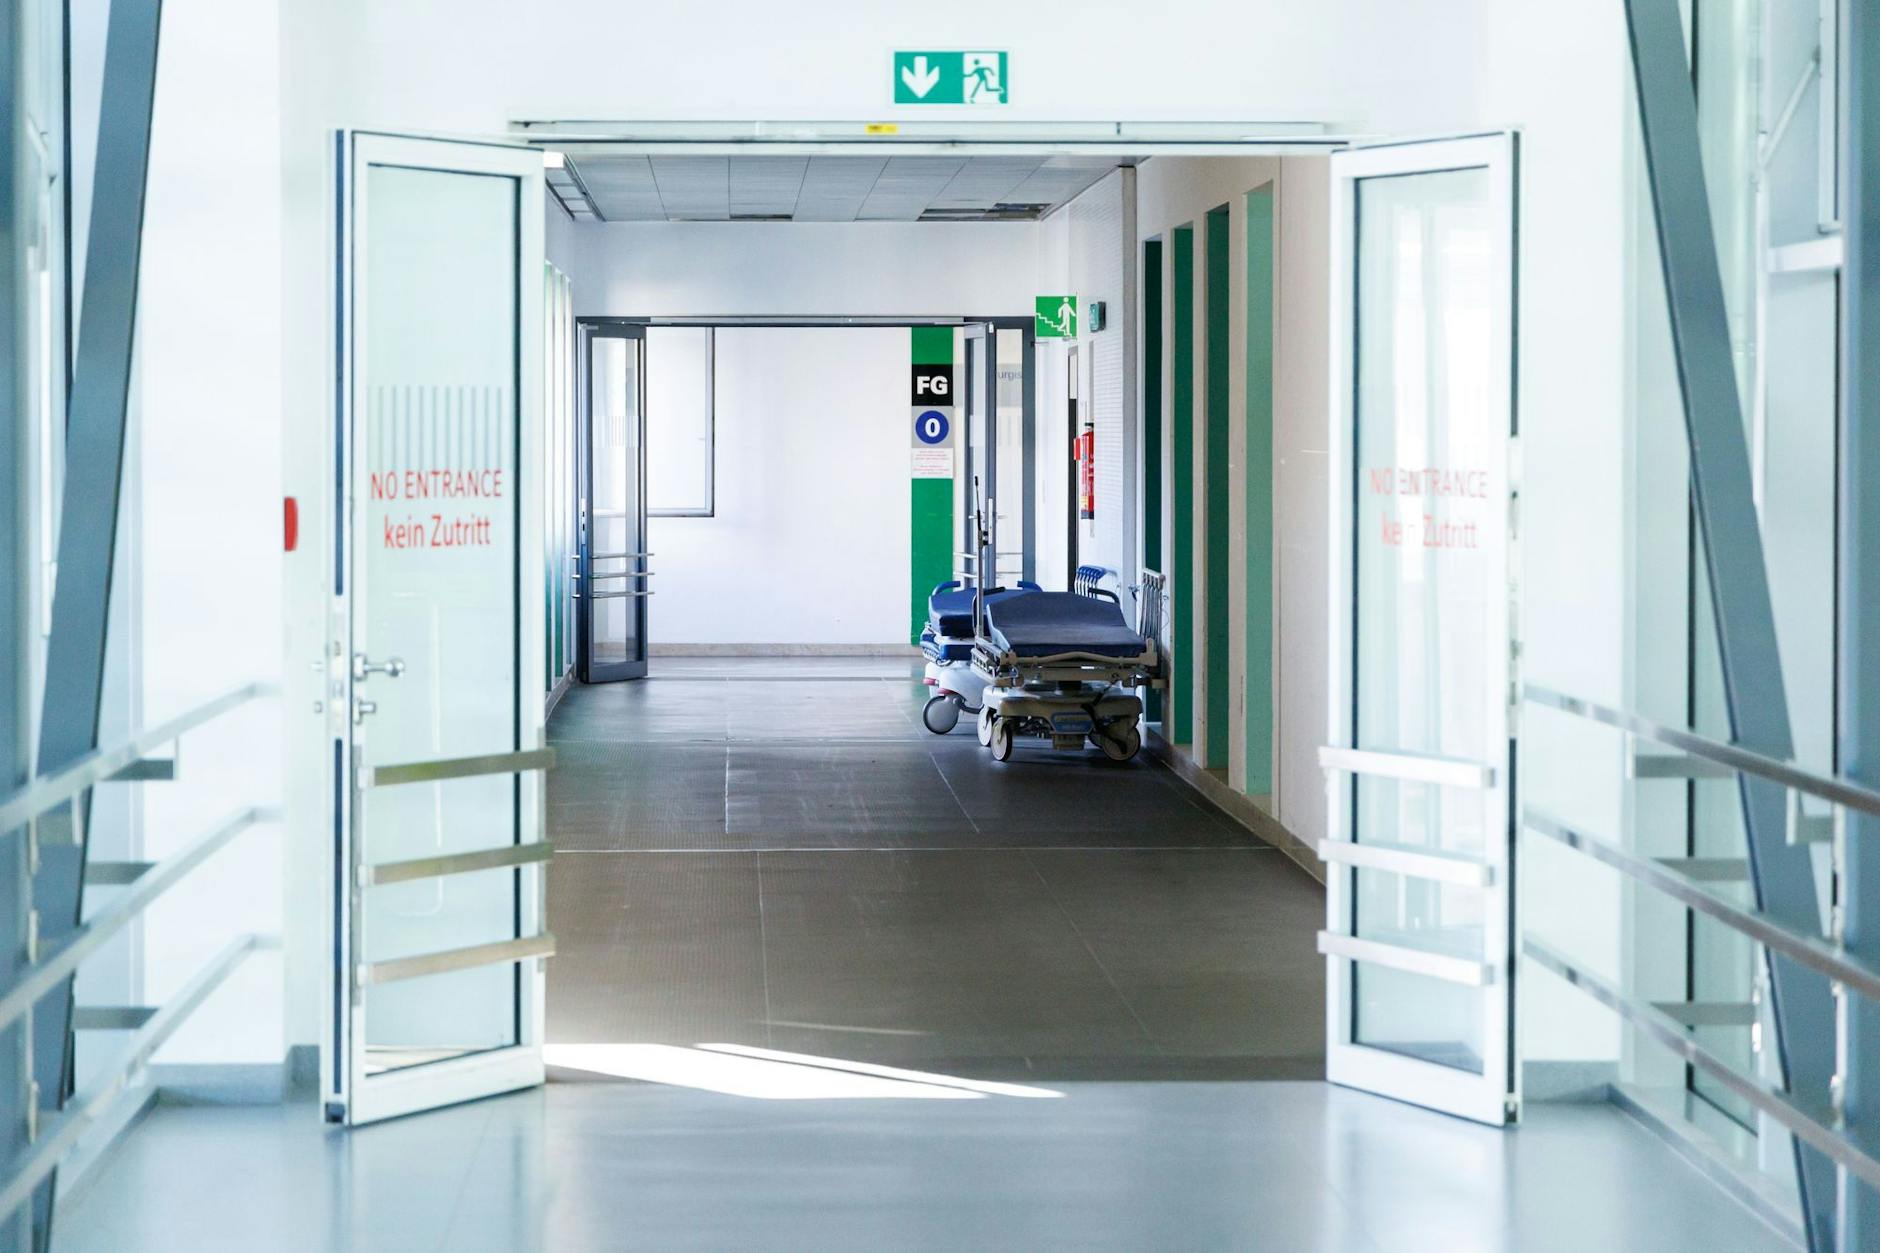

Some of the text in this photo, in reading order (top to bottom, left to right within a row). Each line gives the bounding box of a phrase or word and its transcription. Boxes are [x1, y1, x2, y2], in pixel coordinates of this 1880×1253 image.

[917, 376, 948, 395] FG
[925, 418, 940, 437] 0
[371, 469, 501, 499] NO ENTRANCE
[1370, 468, 1487, 498] NO ENTRANCE
[385, 513, 490, 547] kein Zutritt
[1382, 512, 1478, 548] ke Zutritt
